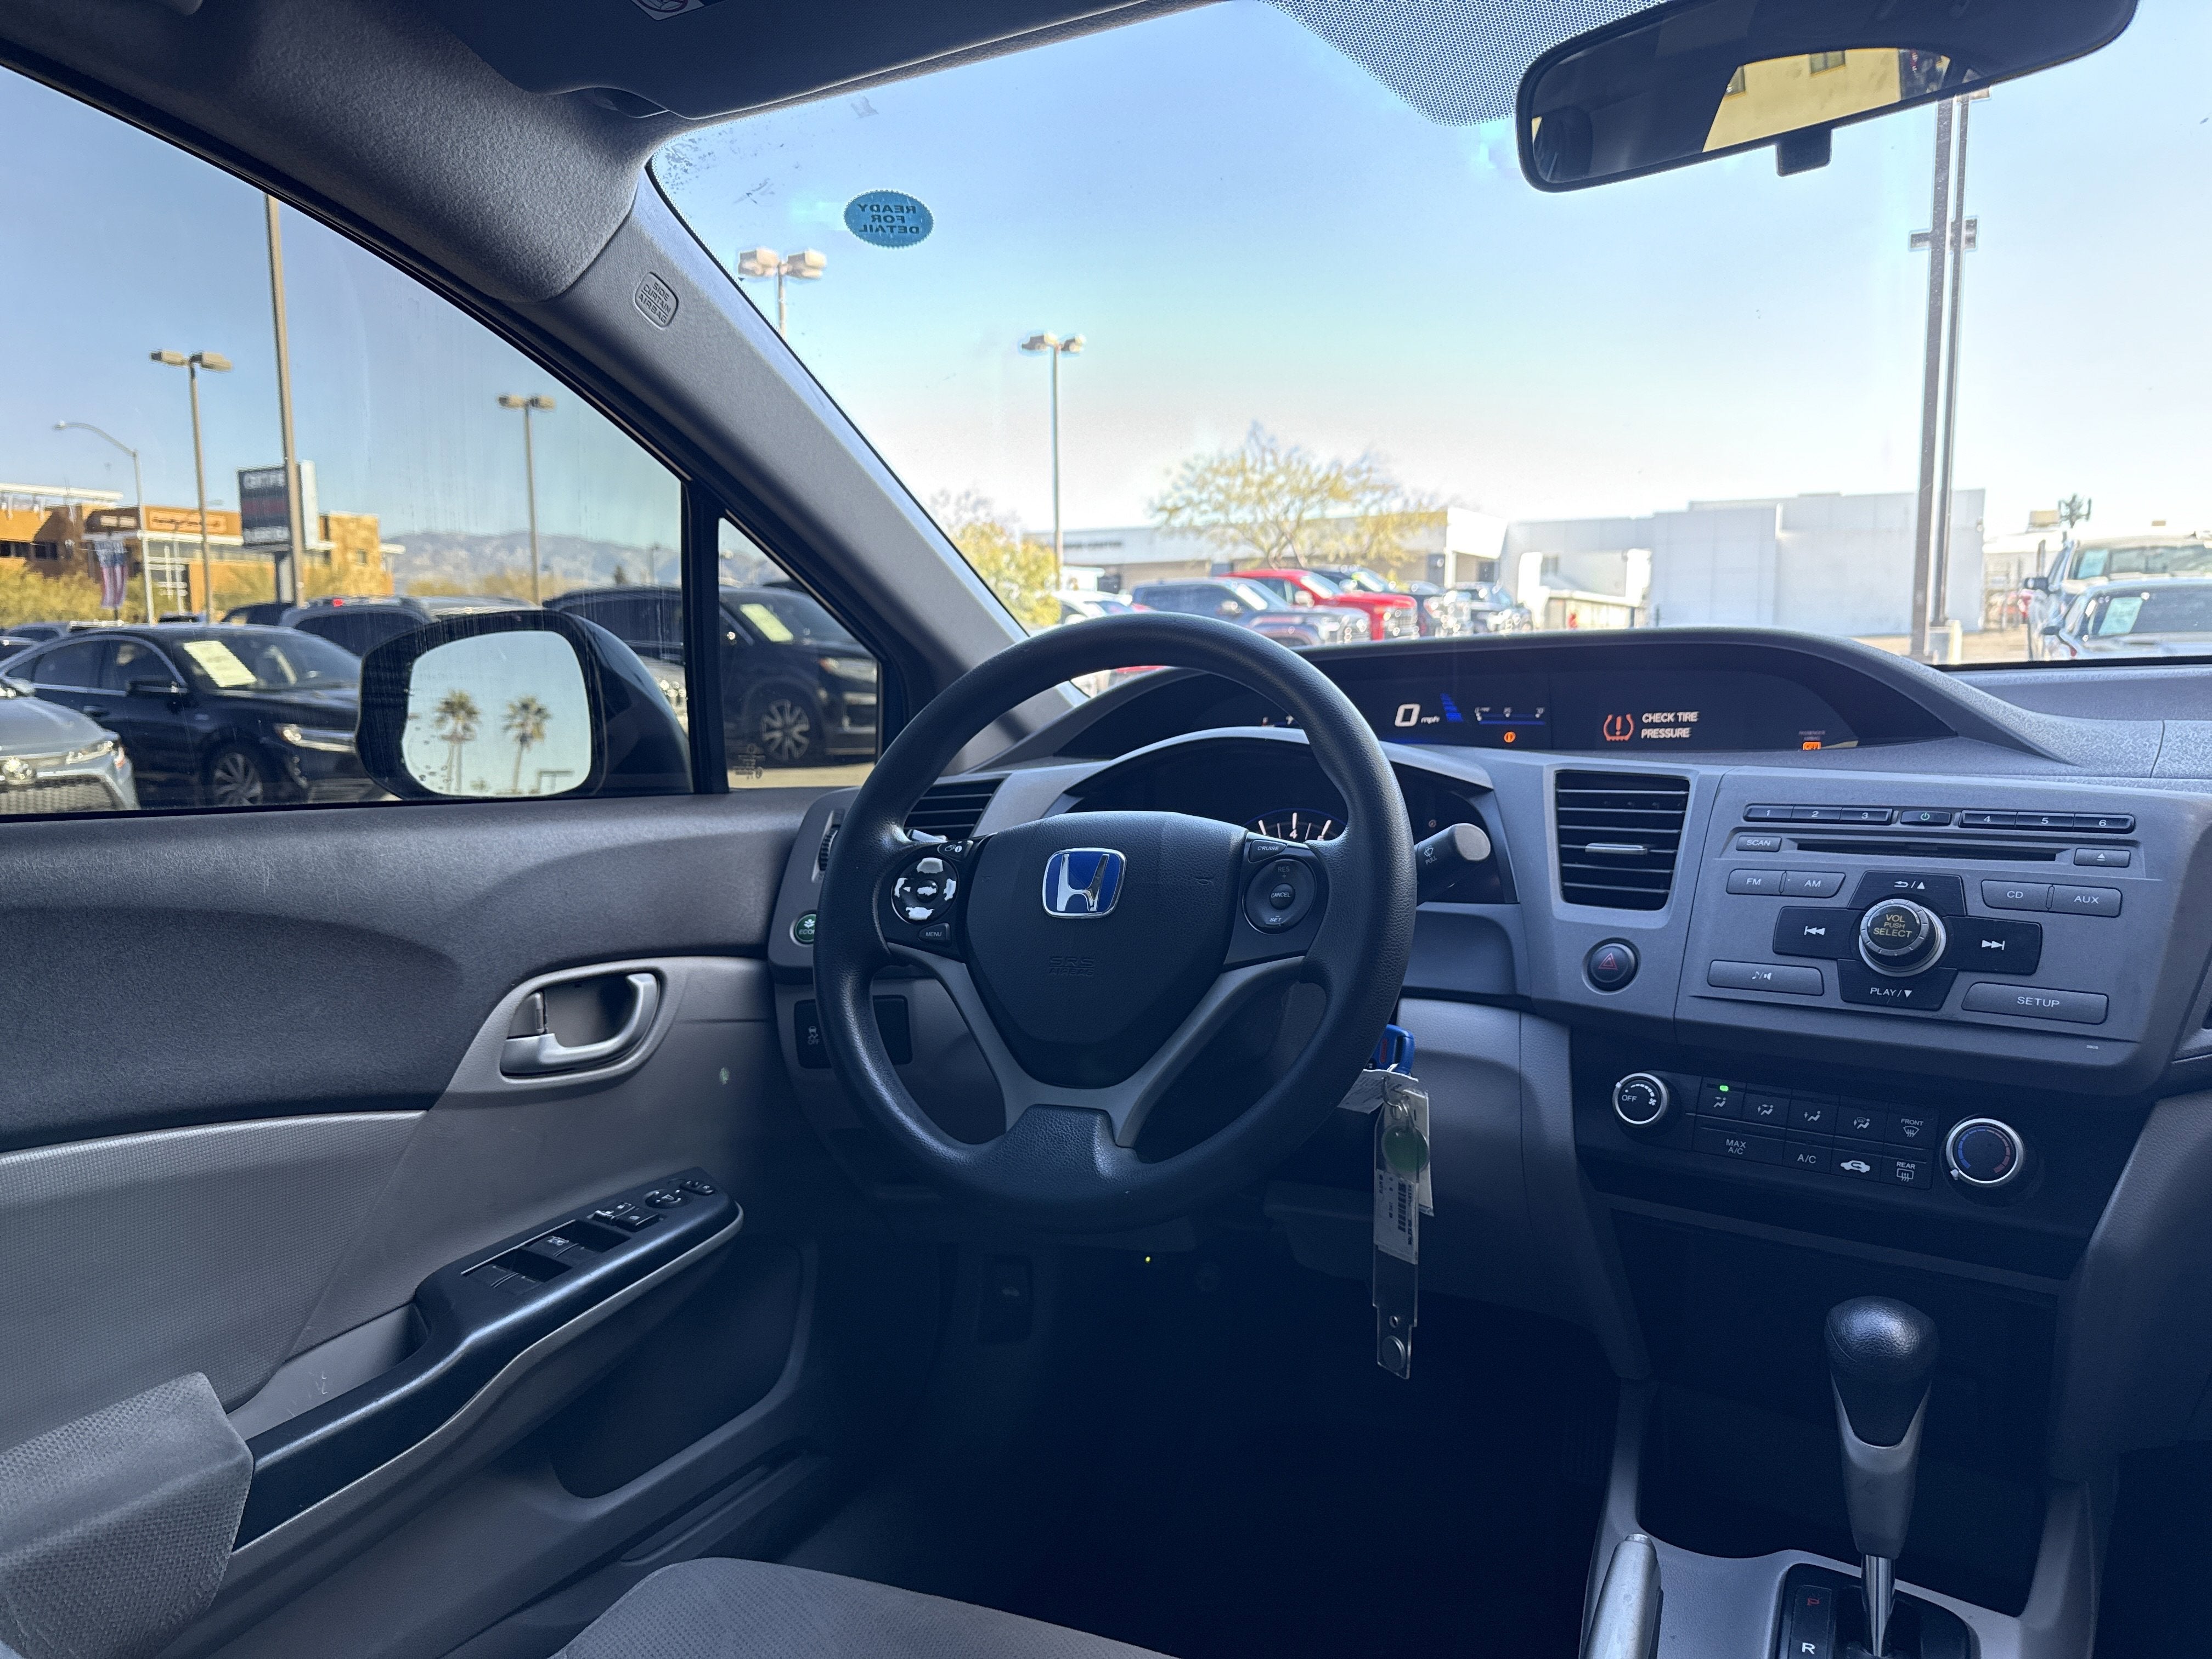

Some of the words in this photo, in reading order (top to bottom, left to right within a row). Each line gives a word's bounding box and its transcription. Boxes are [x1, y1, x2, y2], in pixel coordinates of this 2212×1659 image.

[652, 282, 669, 301] SIDE
[644, 284, 671, 313] CURTAIN
[639, 294, 667, 323] AIRBAG
[1395, 703, 1421, 727] 0
[1420, 715, 1440, 724] mph
[1642, 712, 1675, 723] CHECK
[1677, 711, 1700, 722] TIRE
[1641, 727, 1692, 739] PRESSURE
[2006, 890, 2024, 899] CD
[2074, 895, 2099, 904] AUX
[1886, 914, 1905, 923] VOL
[1873, 927, 1912, 938] SELECT
[2017, 996, 2060, 1007] SETUP
[1726, 1138, 1746, 1148] MAX
[1728, 1147, 1743, 1155] A/C
[1797, 1154, 1816, 1164] A/C
[1896, 1161, 1916, 1170] REAR
[1807, 1598, 1820, 1606] P
[1802, 1642, 1816, 1655] R
